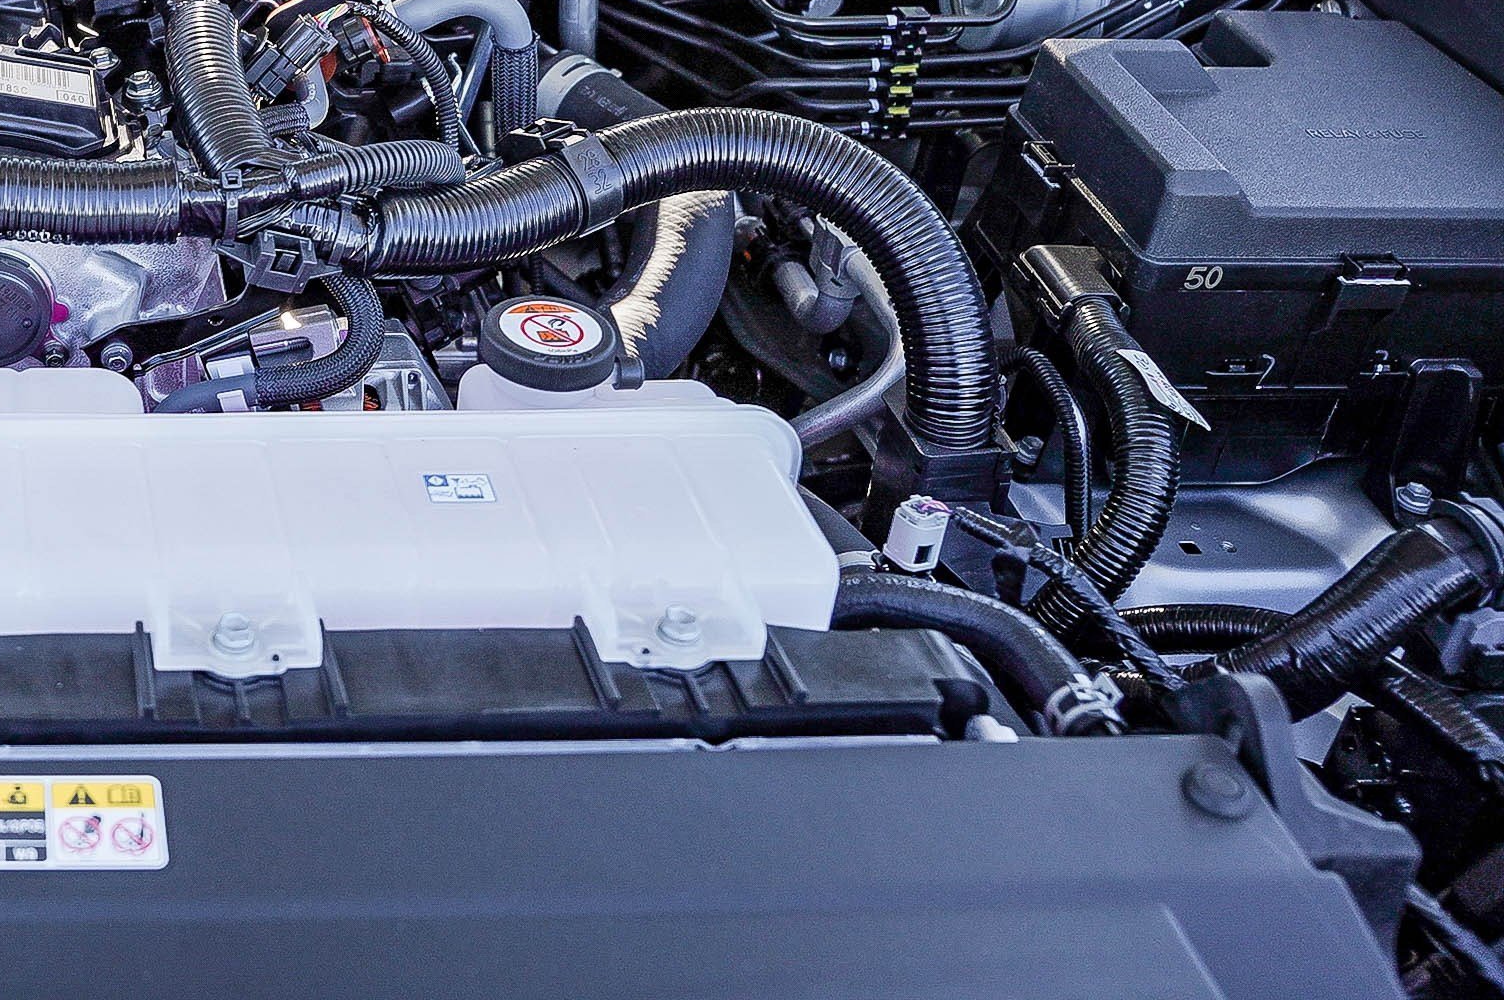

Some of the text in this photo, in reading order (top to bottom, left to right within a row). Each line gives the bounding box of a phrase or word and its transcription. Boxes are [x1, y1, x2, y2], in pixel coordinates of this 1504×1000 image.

[62, 94, 86, 104] 040
[1305, 129, 1361, 139] RELAY
[1377, 129, 1427, 139] FUSE
[587, 168, 613, 195] 32
[1183, 265, 1224, 290] 50
